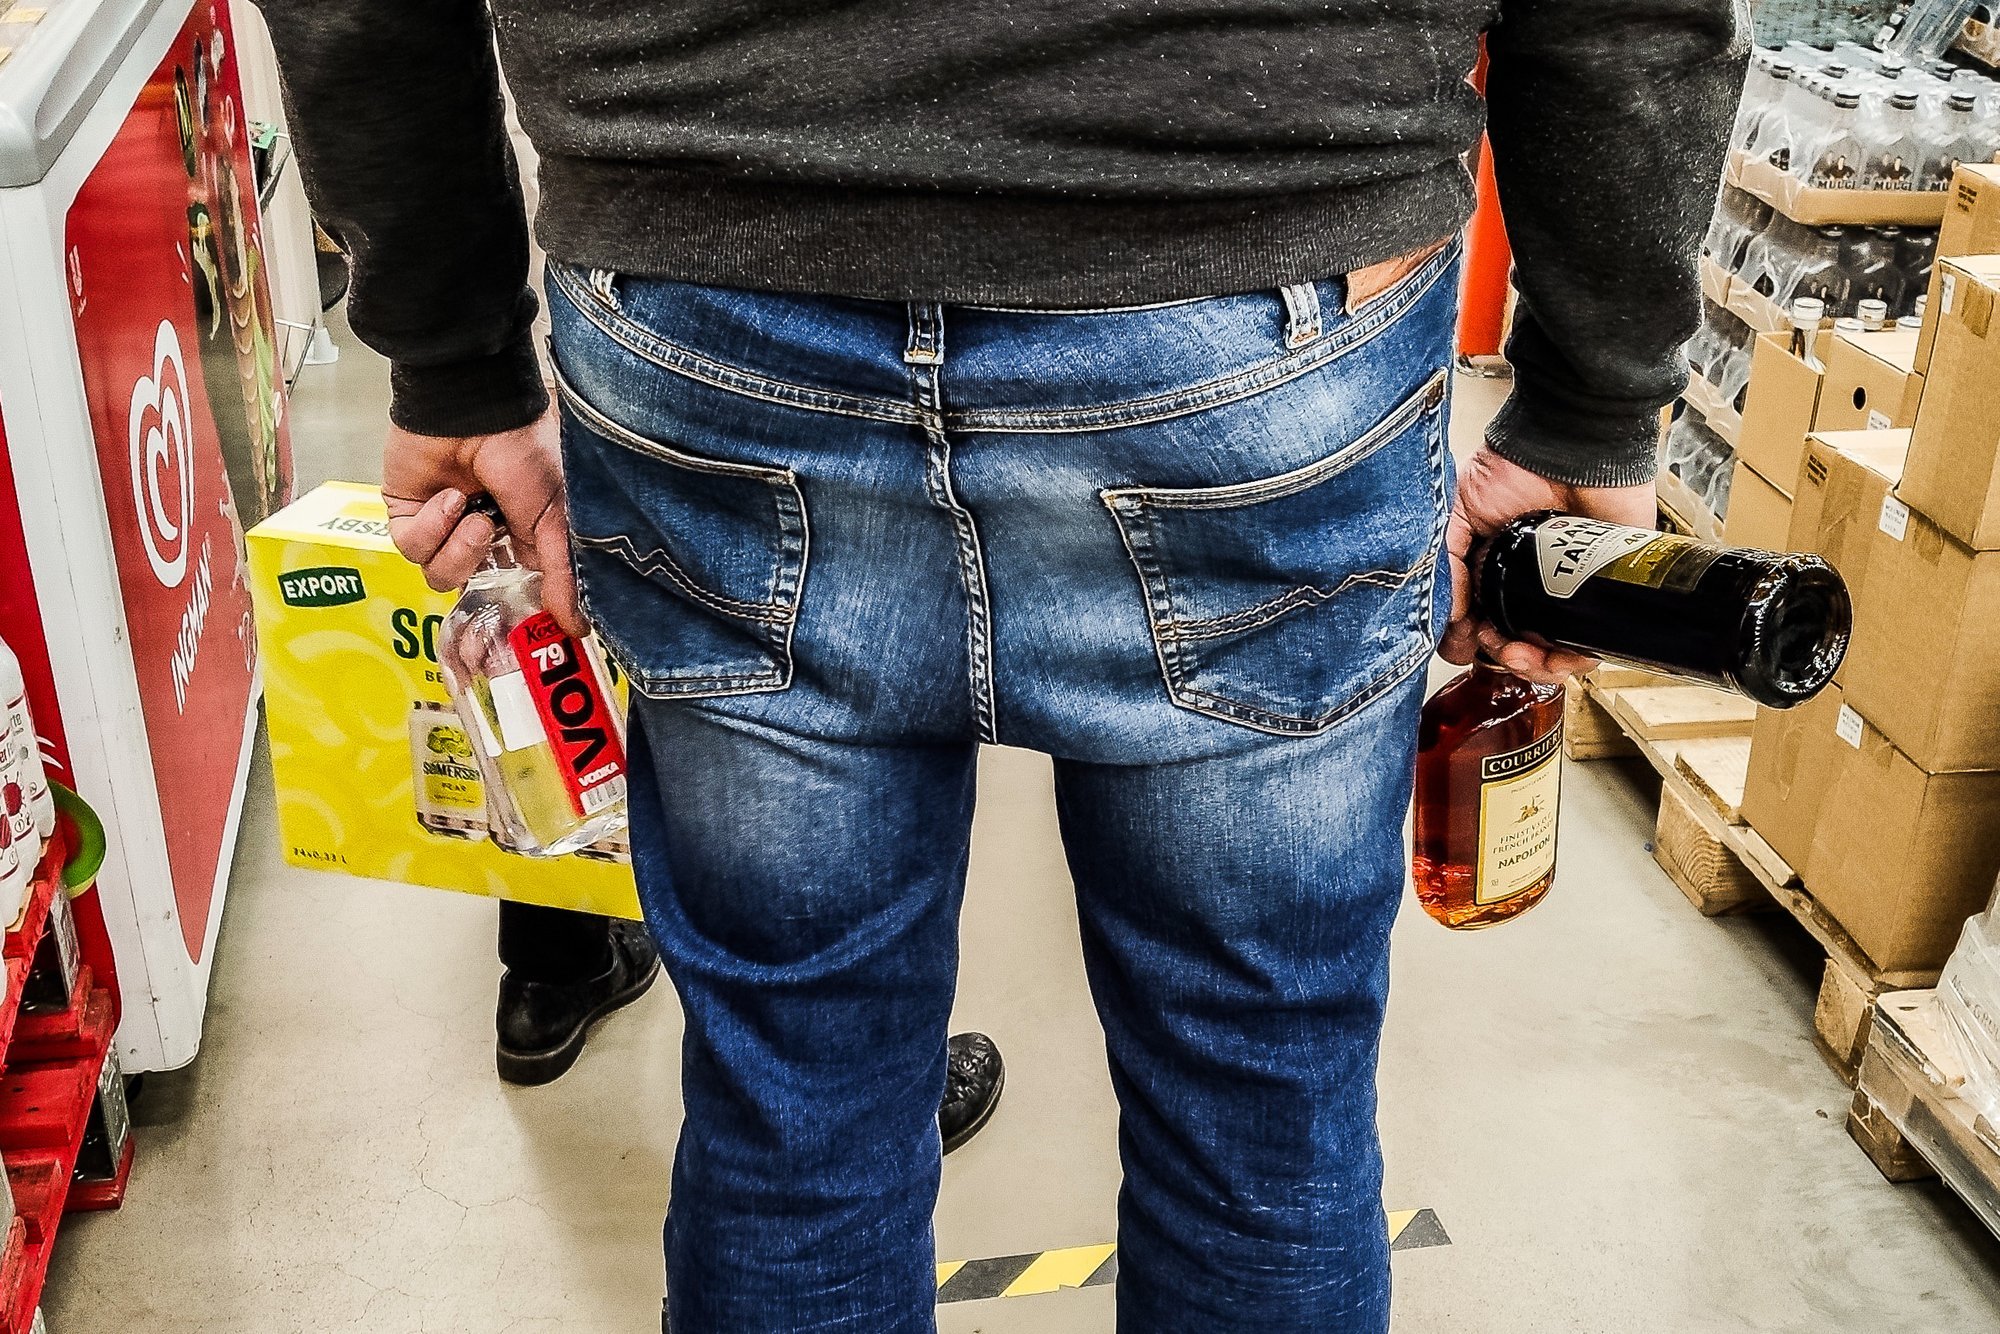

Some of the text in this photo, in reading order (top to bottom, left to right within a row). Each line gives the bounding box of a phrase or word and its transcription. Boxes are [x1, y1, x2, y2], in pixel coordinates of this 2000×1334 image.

[1817, 180, 1856, 190] MULGI
[1873, 181, 1912, 191] MULGI
[1929, 182, 1949, 192] MU
[316, 517, 390, 537] RSBY
[1623, 533, 1649, 546] 40
[282, 574, 359, 599] EXPORT
[170, 531, 213, 716] INGMAN
[391, 607, 445, 663] SO
[530, 642, 566, 673] 79
[425, 670, 444, 683] BE
[539, 636, 609, 774] VOL
[578, 761, 621, 787] VODKA
[1492, 836, 1529, 855] FRENCH
[1500, 827, 1530, 845] FINEST
[1497, 833, 1551, 870] NAPOLEON
